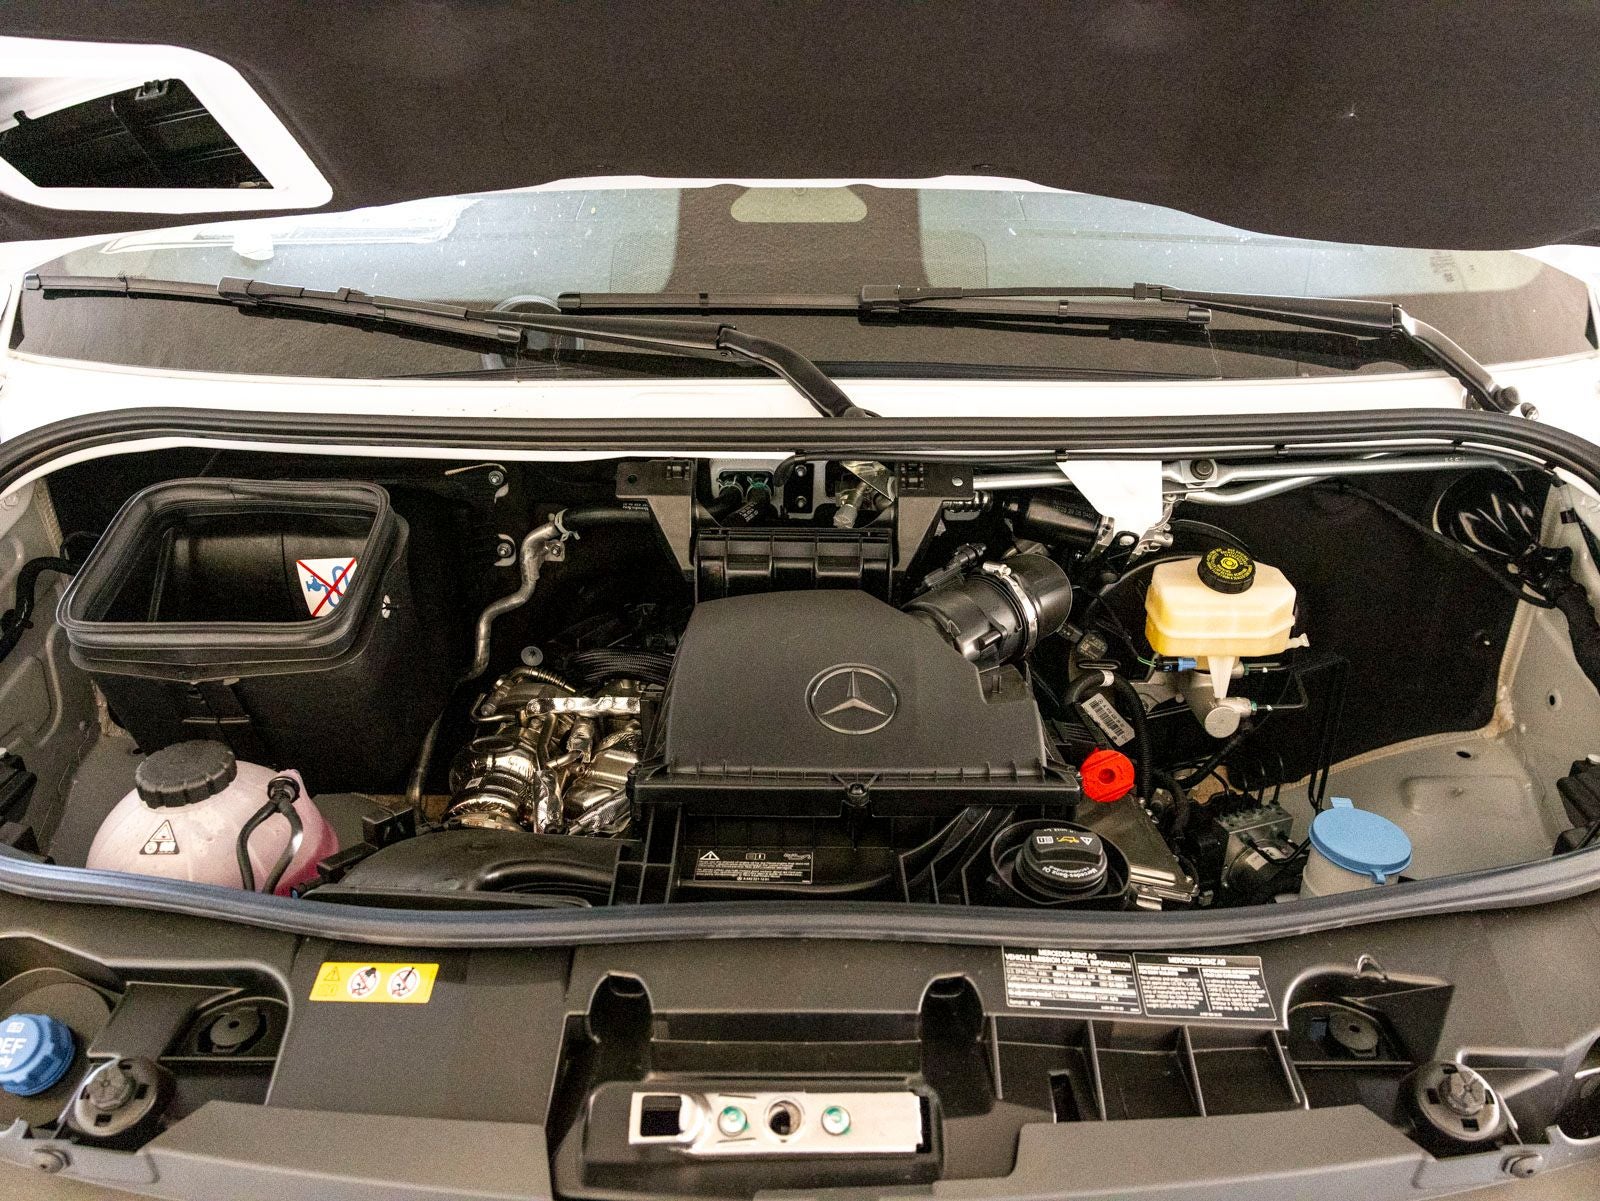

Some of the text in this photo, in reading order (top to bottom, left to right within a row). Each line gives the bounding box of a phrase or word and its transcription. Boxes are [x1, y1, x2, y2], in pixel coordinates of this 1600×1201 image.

[1060, 957, 1089, 966] CONTROL
[1090, 960, 1131, 968] INFORMATION
[0, 1037, 27, 1054] EF
